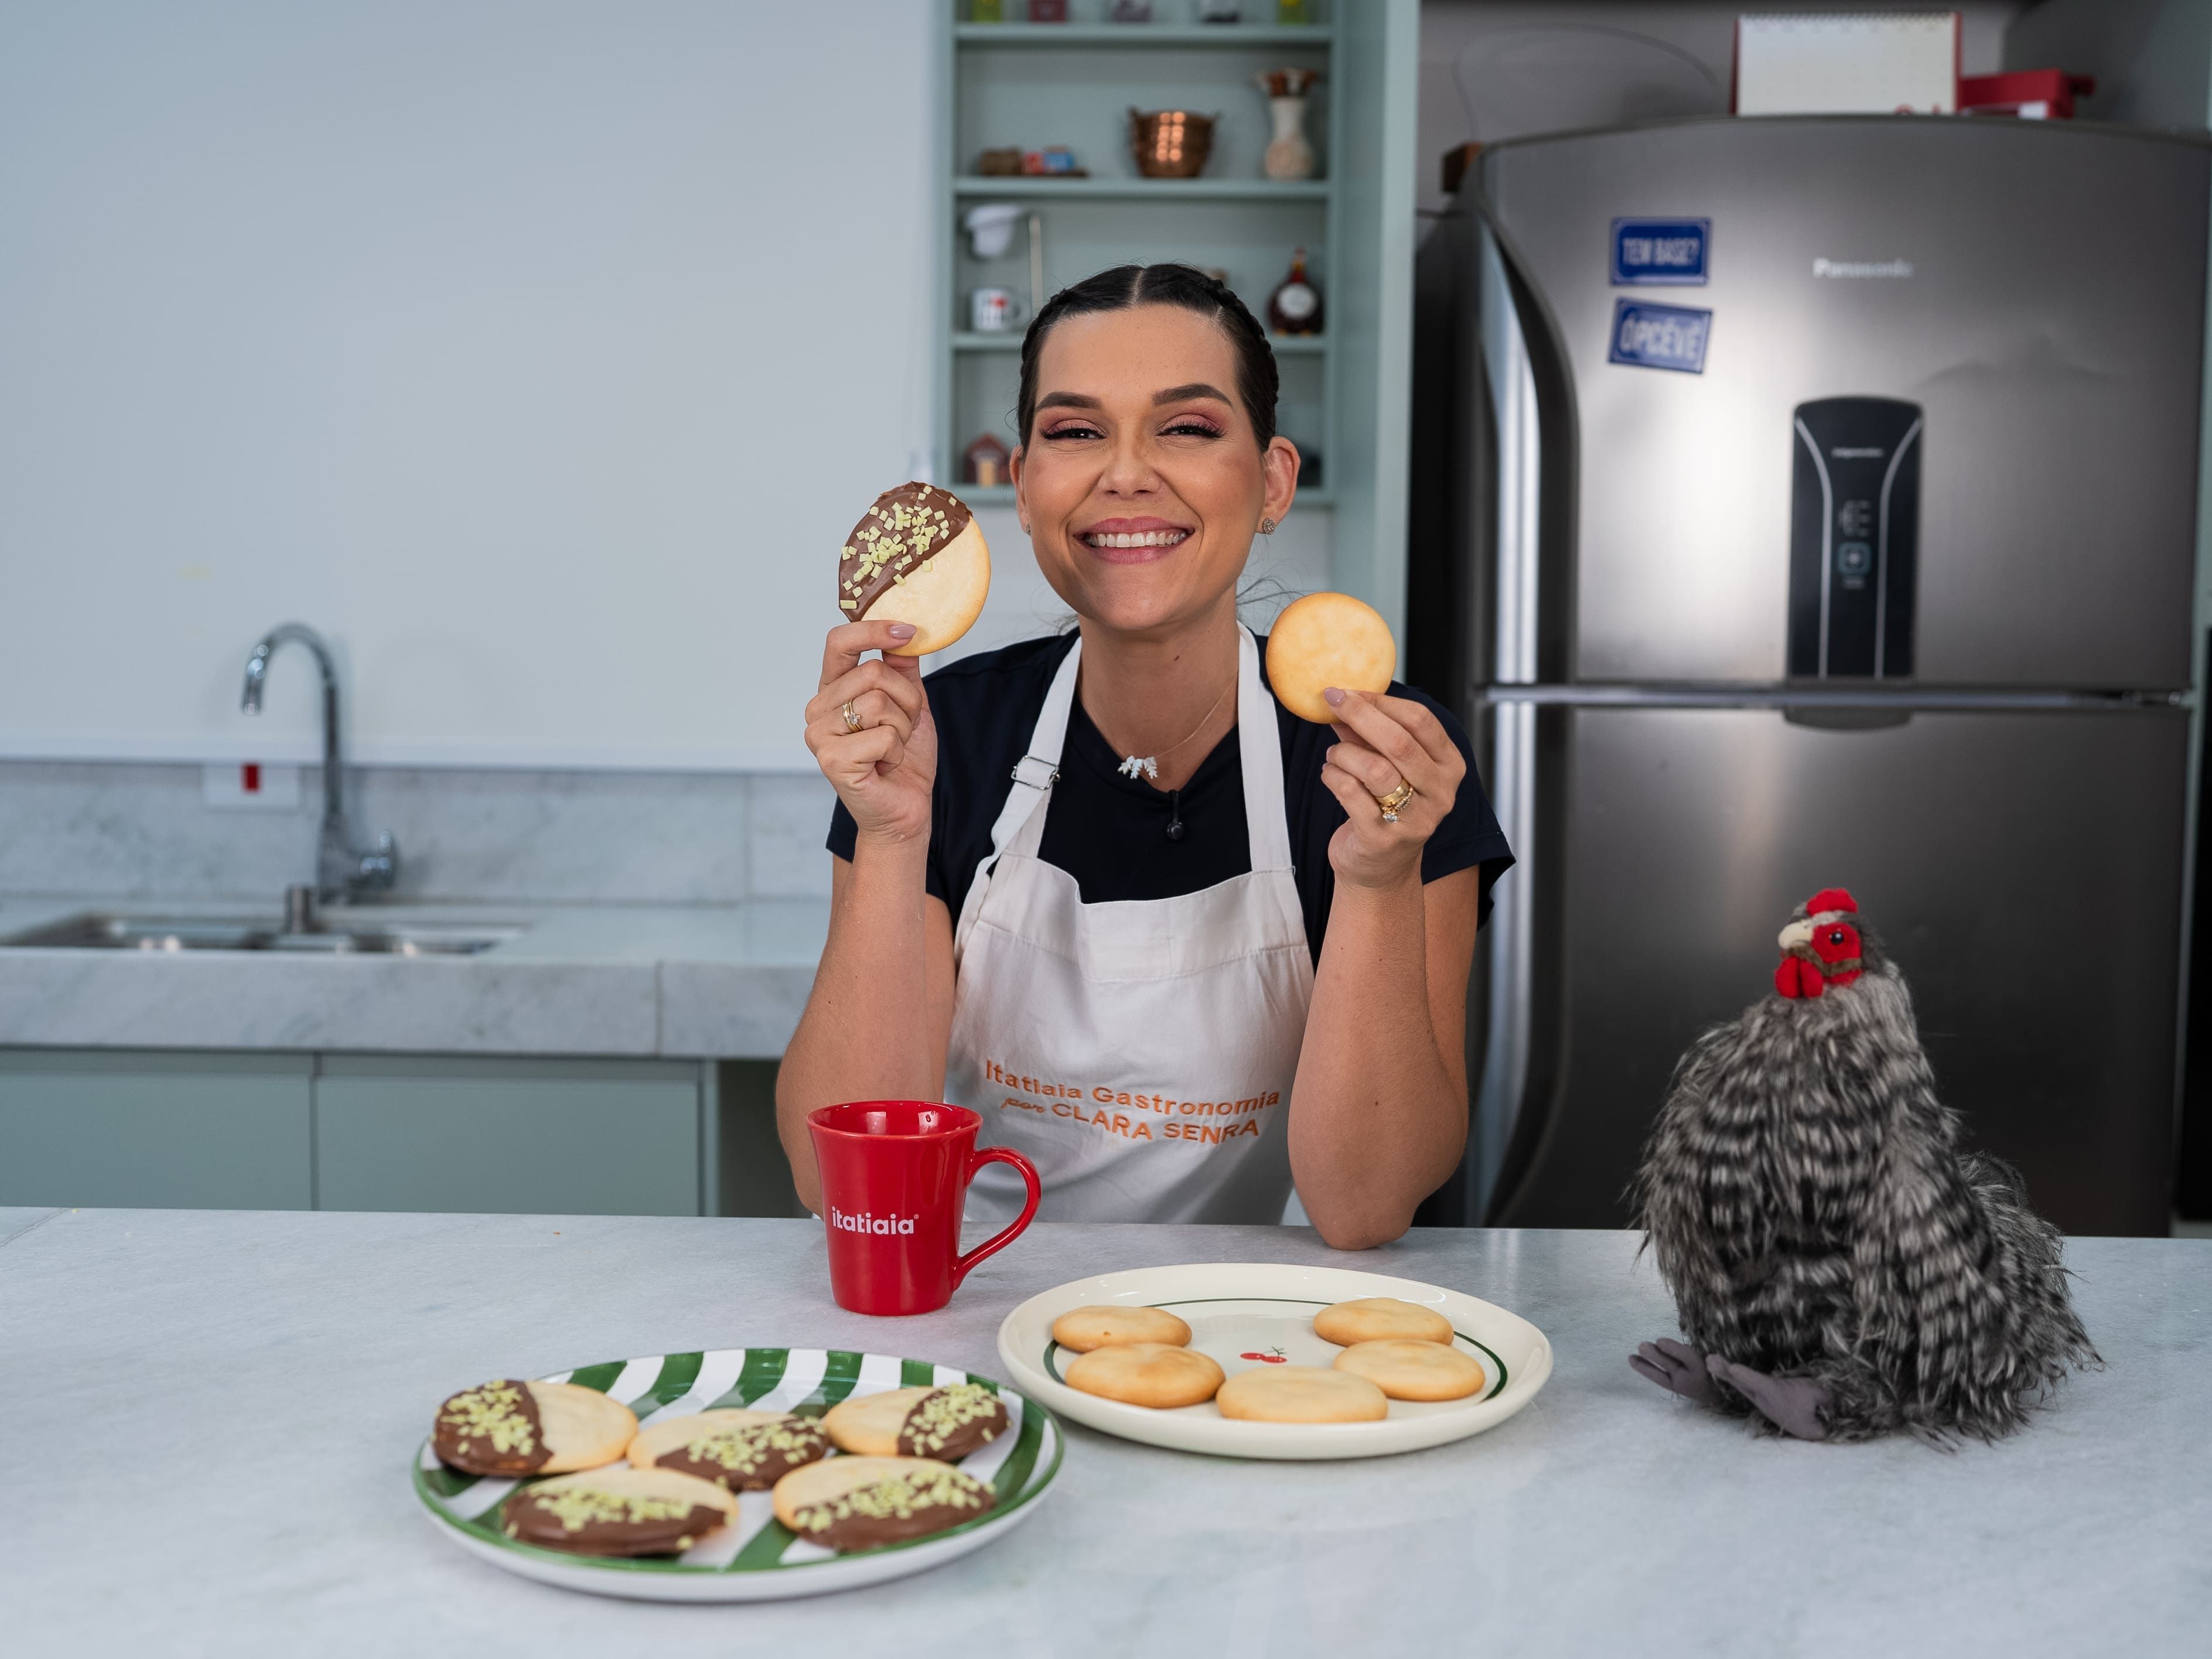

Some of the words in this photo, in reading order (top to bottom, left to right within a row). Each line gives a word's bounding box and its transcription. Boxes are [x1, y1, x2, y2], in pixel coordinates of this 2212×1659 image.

[1622, 237, 1652, 265] TEM
[986, 1059, 1082, 1099] Itatiaia
[1092, 1086, 1279, 1116] Gastronomia
[1001, 1097, 1045, 1113] por
[1052, 1102, 1153, 1141] CLARA
[1163, 1119, 1259, 1144] SENRA
